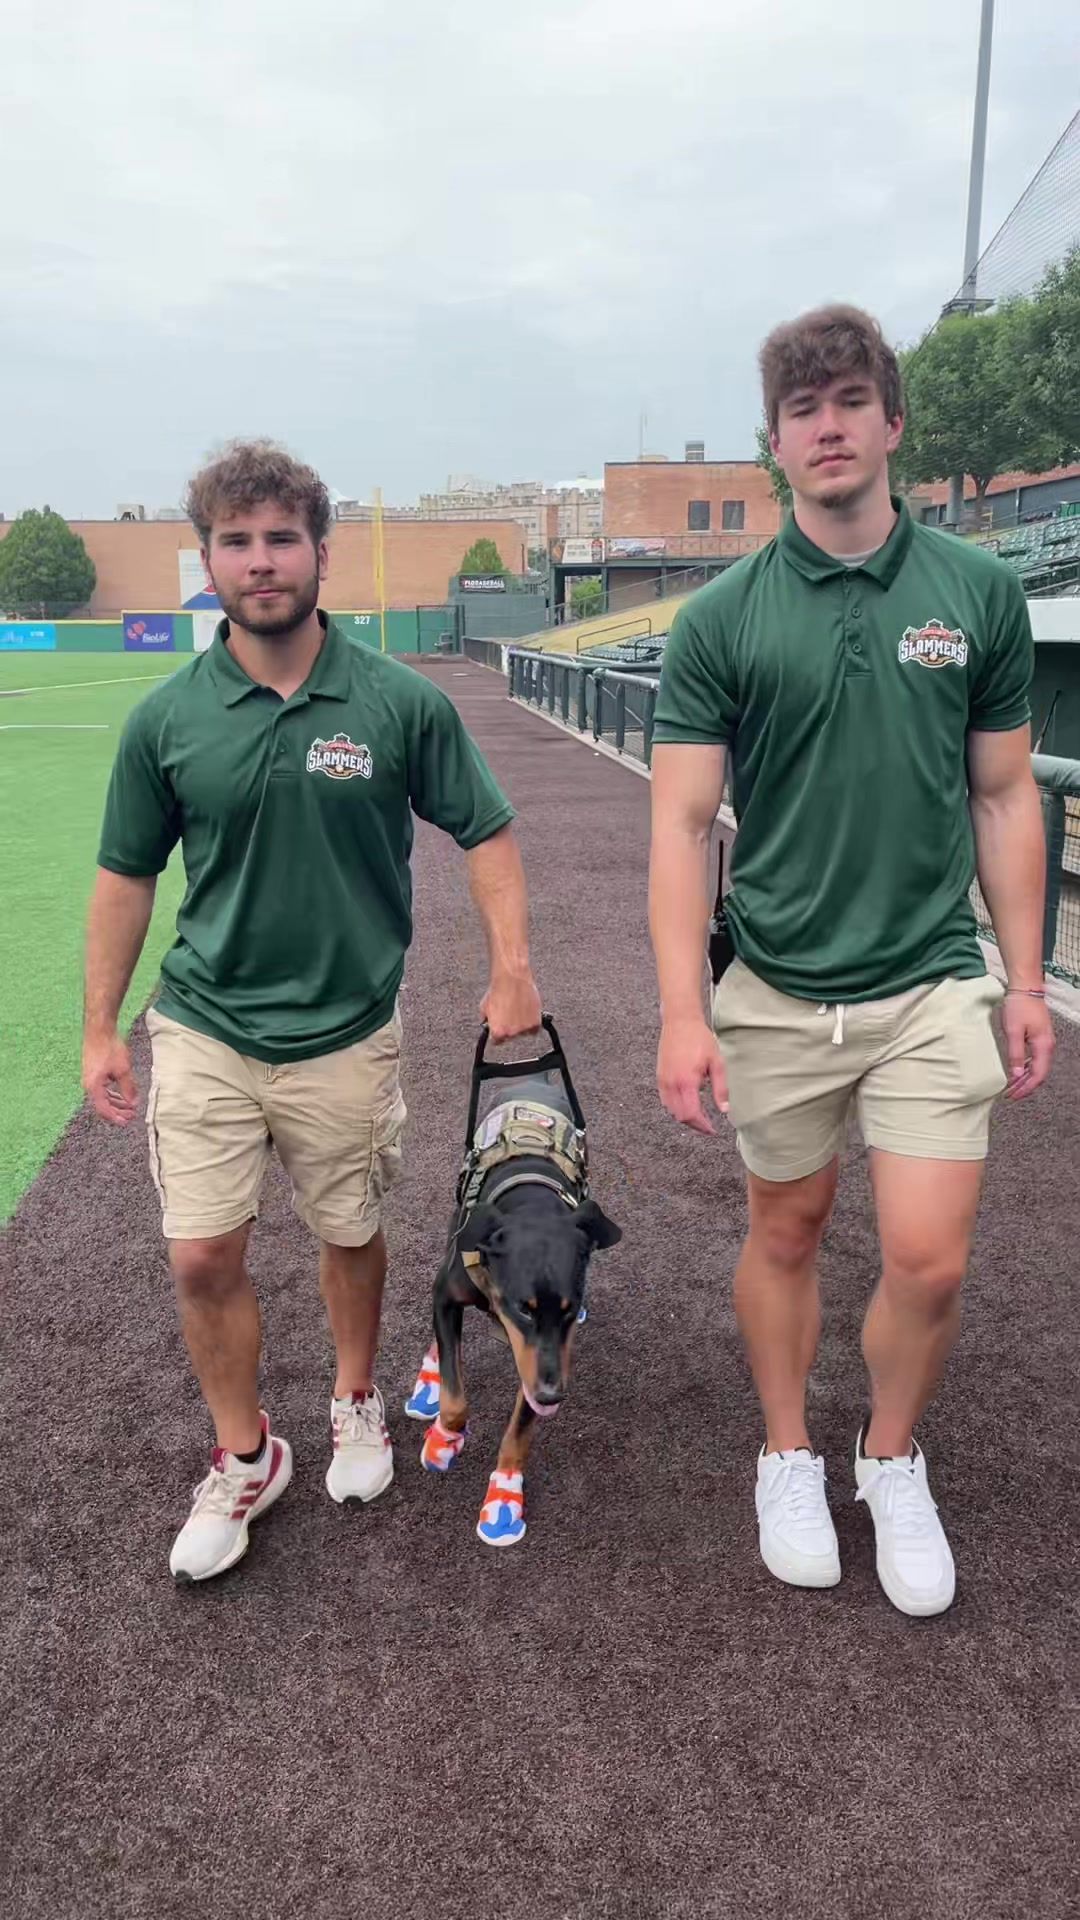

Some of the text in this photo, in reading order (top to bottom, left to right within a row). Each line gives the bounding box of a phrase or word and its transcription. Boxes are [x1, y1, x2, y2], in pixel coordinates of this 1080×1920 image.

[353, 615, 370, 625] 327
[900, 639, 966, 663] SLAMMERS
[308, 751, 371, 776] SLAMMERS
